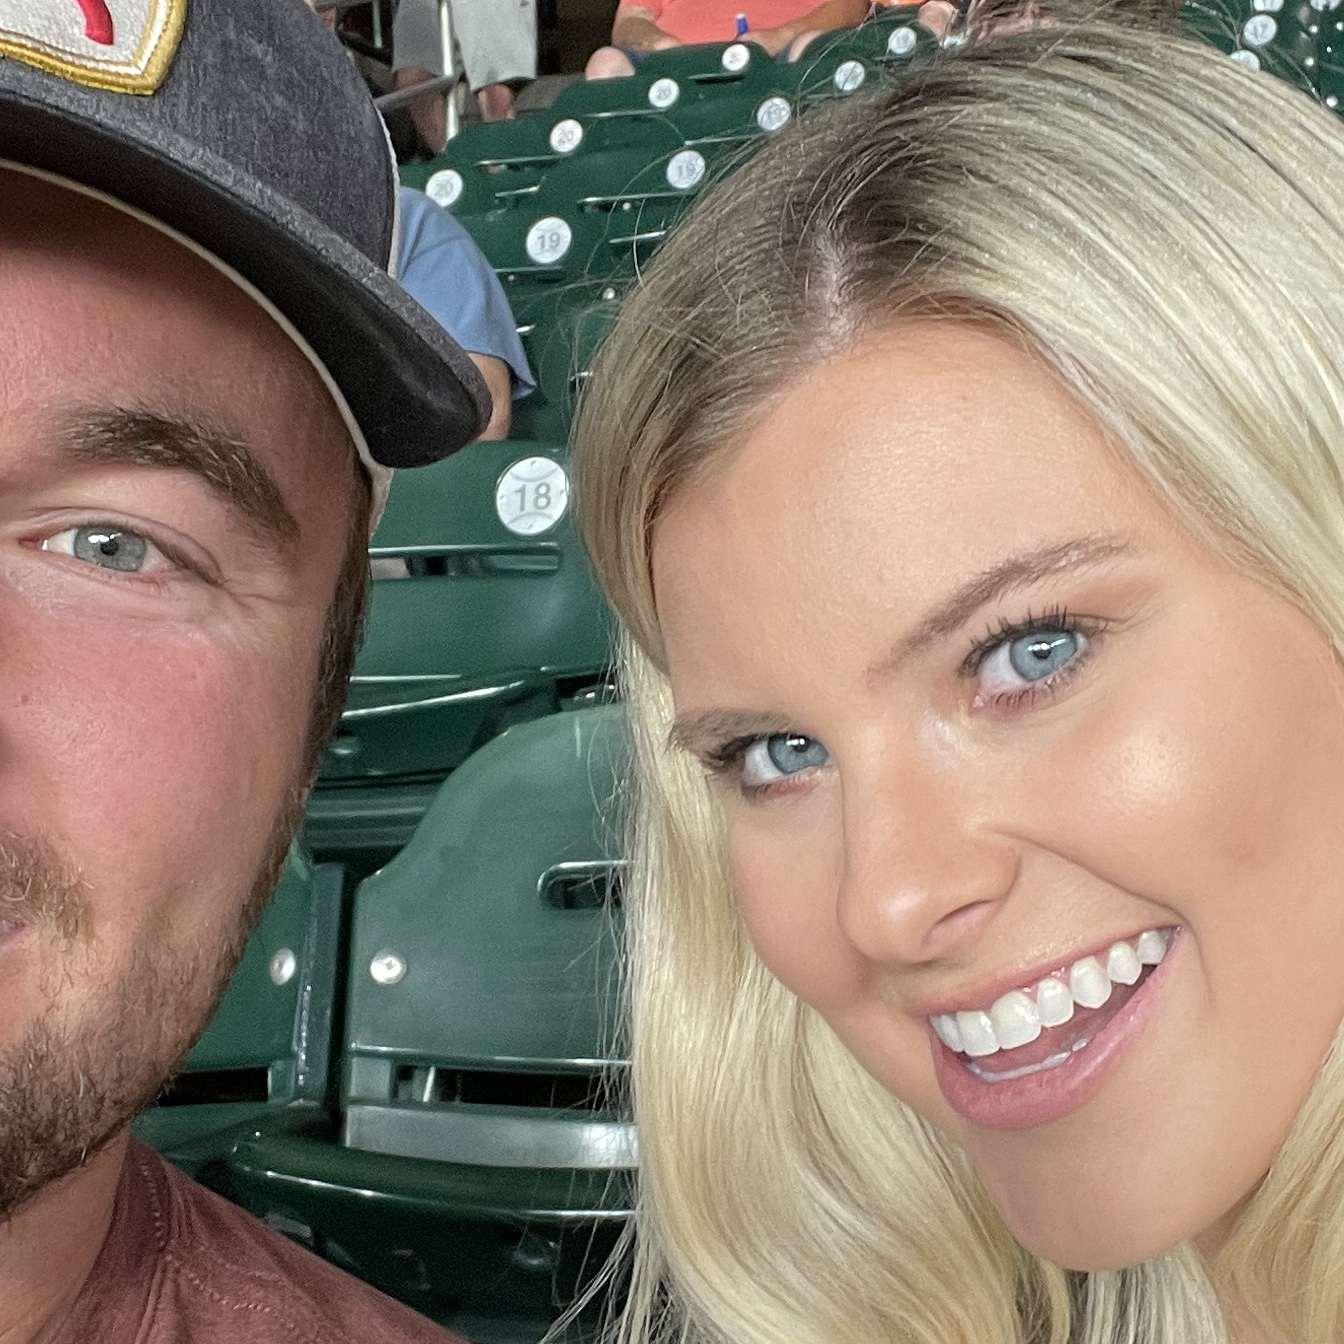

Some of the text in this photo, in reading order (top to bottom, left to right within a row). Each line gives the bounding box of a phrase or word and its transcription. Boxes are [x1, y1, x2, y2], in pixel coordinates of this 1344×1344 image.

[558, 129, 574, 145] 20
[536, 230, 562, 251] 19
[513, 482, 552, 512] 18
